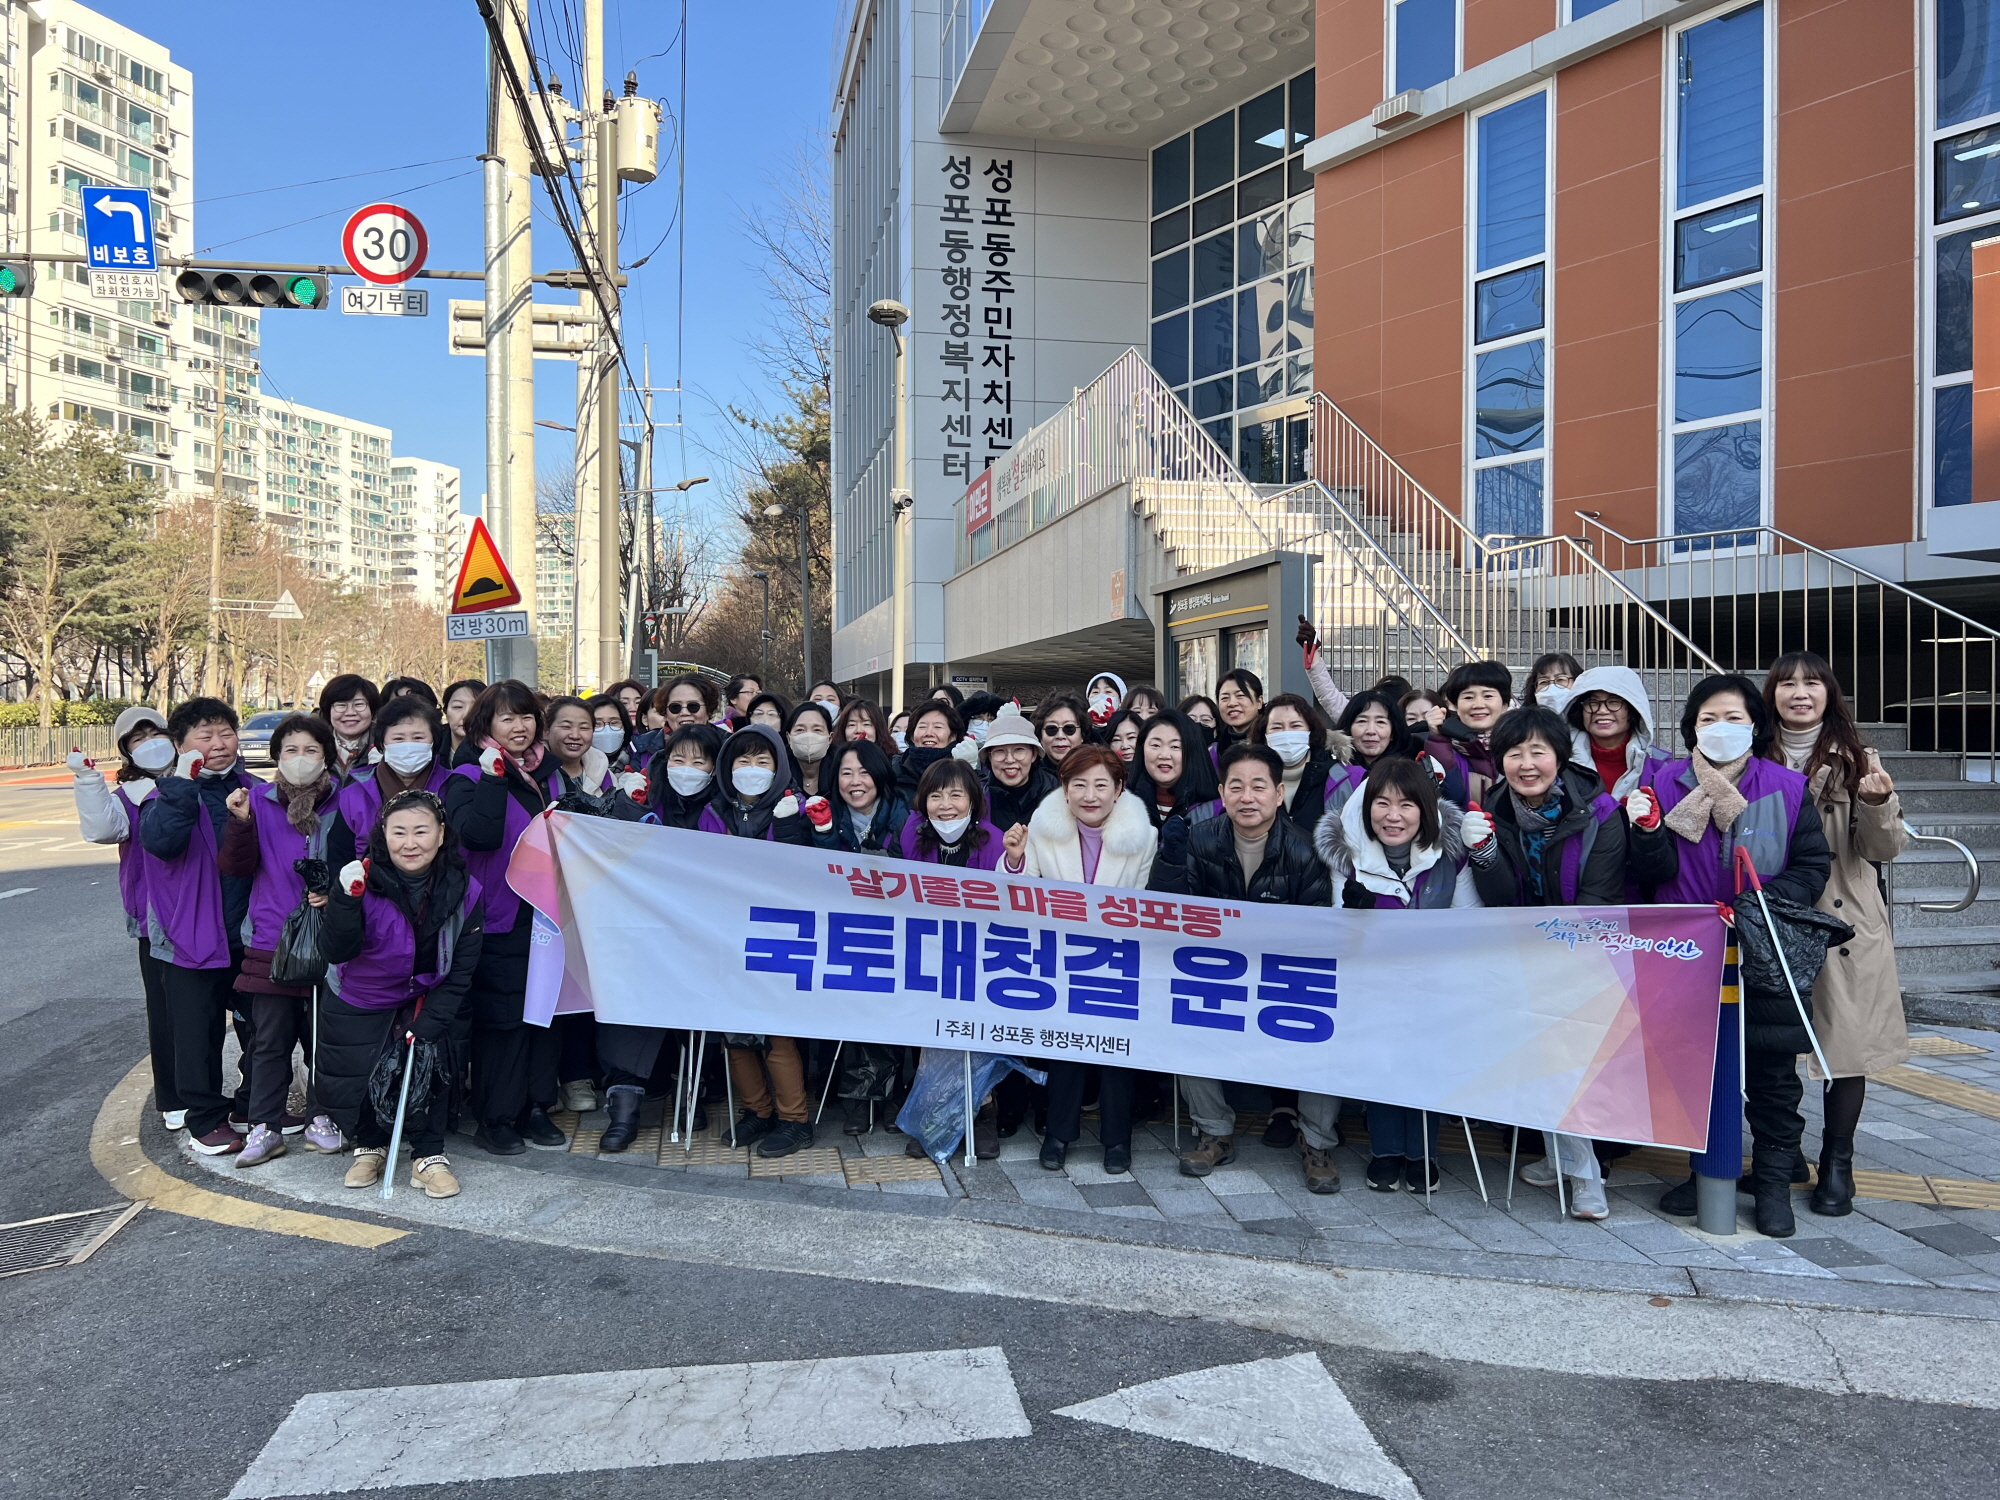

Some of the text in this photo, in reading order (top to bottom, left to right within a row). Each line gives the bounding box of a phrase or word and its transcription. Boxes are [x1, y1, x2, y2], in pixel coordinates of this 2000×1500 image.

[93, 245, 151, 266] 비보호
[362, 227, 412, 262] 30
[95, 273, 154, 287] 직진신호시
[96, 285, 156, 299] 좌회전가능
[346, 291, 426, 314] 여기부터
[940, 155, 974, 485] 성포동행정복지센터
[450, 617, 525, 637] 전방30m
[827, 864, 1241, 938] "살기좋은 마을 성포동"
[1656, 938, 1701, 958] 안산
[744, 906, 1338, 1043] 국토대청결 운동
[989, 1023, 1034, 1047] 성포동
[1040, 1028, 1131, 1057] 행정복지센터
